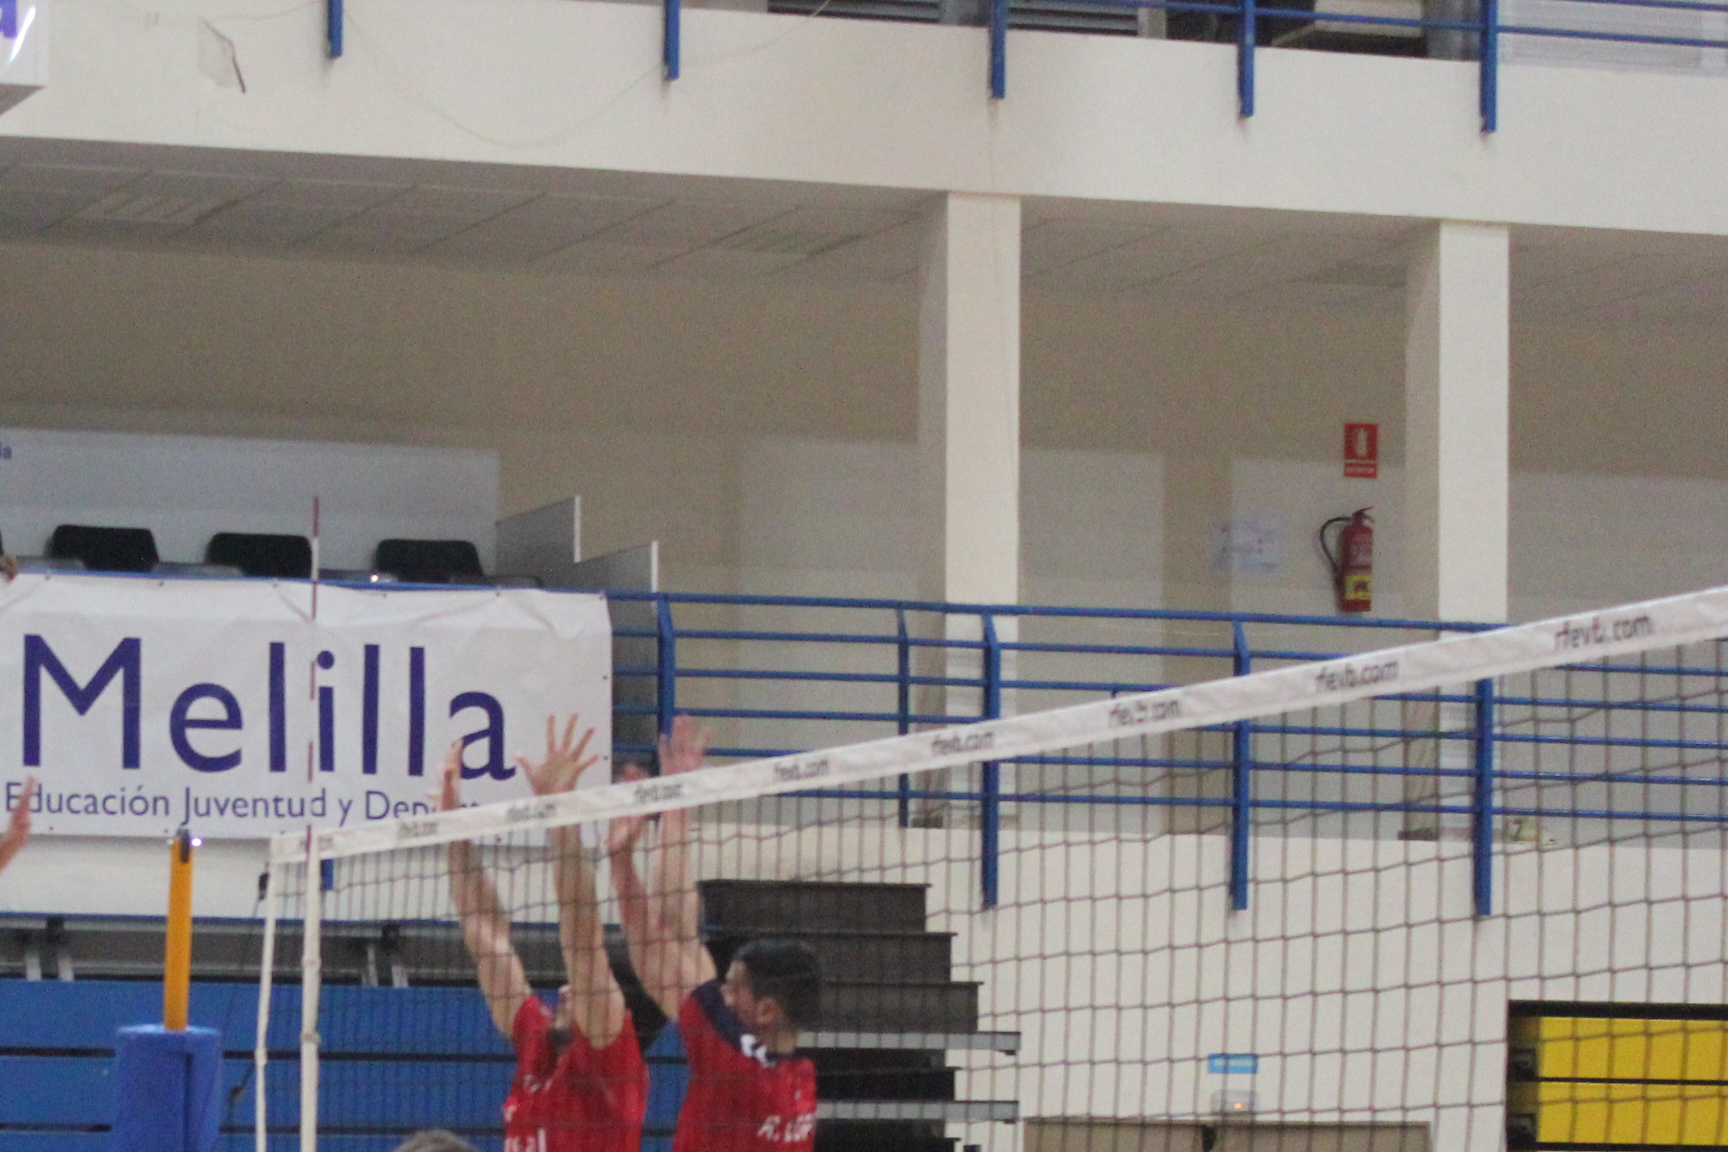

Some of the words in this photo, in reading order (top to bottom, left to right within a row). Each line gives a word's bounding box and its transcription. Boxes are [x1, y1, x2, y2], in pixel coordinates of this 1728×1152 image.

[22, 633, 518, 782] Melilla
[5, 779, 170, 819] Educación
[182, 786, 326, 828] Juventud
[338, 798, 353, 828] y
